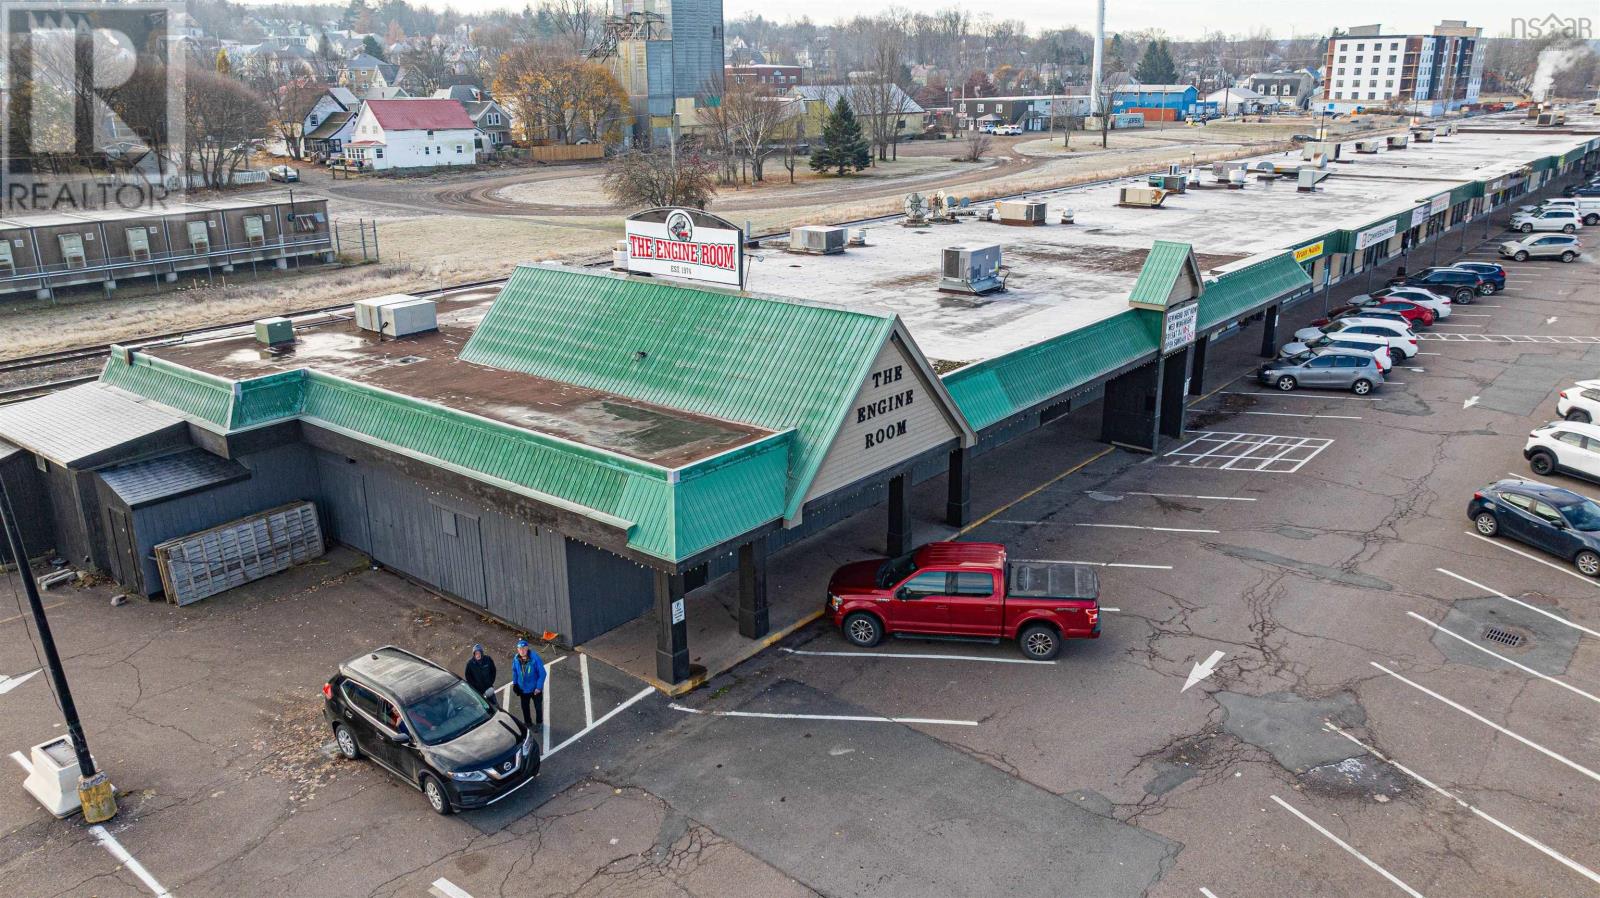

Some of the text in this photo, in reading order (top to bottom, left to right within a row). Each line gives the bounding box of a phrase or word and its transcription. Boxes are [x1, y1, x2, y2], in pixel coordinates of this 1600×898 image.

[629, 235, 735, 270] THE ENGINE ROOM
[872, 365, 902, 388] THE
[857, 389, 913, 423] ENGINE
[865, 419, 907, 449] ROOM
